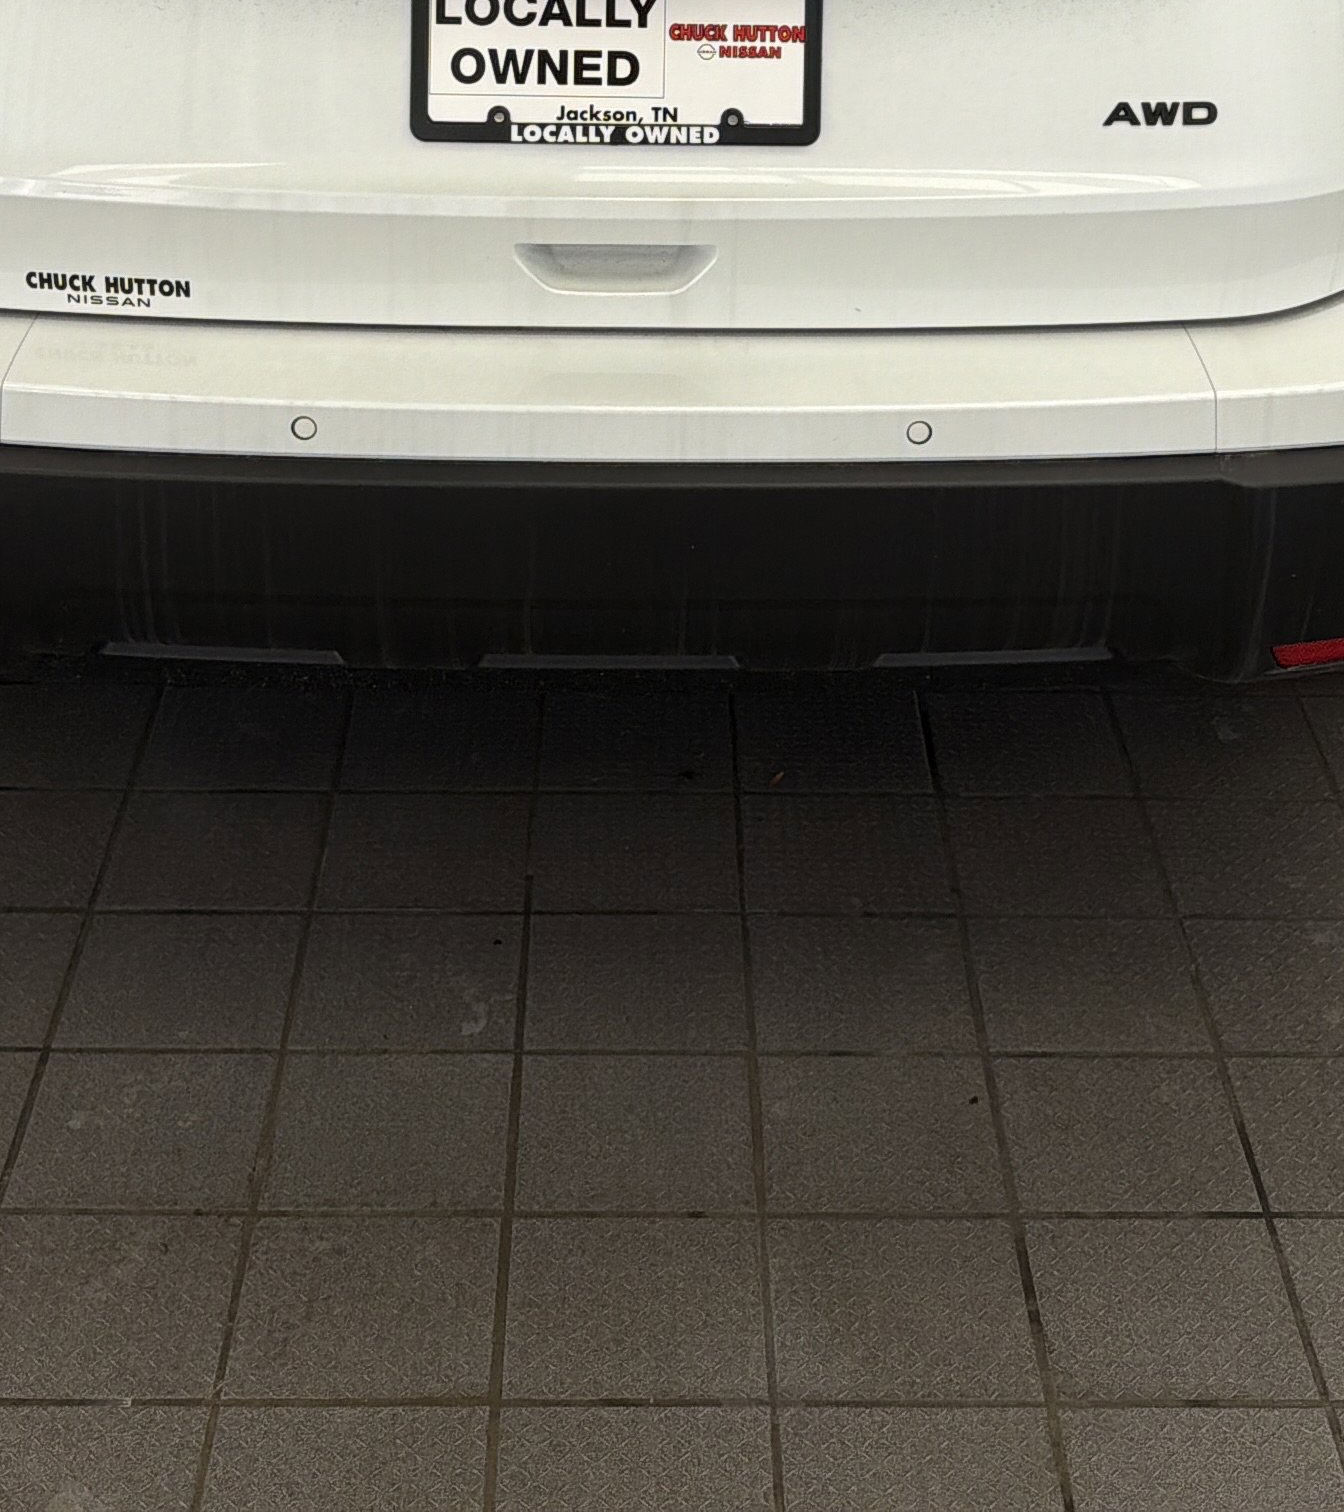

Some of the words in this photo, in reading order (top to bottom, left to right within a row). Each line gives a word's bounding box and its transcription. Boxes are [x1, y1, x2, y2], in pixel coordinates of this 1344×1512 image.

[669, 23, 728, 42] CHUCK
[733, 24, 806, 43] HUTTON
[719, 45, 782, 59] NISSAN
[450, 47, 640, 87] OWNED
[556, 104, 644, 125] Jackson,
[651, 106, 678, 123] TN
[1102, 101, 1218, 126] AWD
[510, 124, 616, 144] LOCALLY
[625, 125, 721, 145] OWNED
[25, 271, 96, 293] CHUCK
[104, 276, 191, 298] HUTTON
[67, 294, 151, 308] NISSAN
